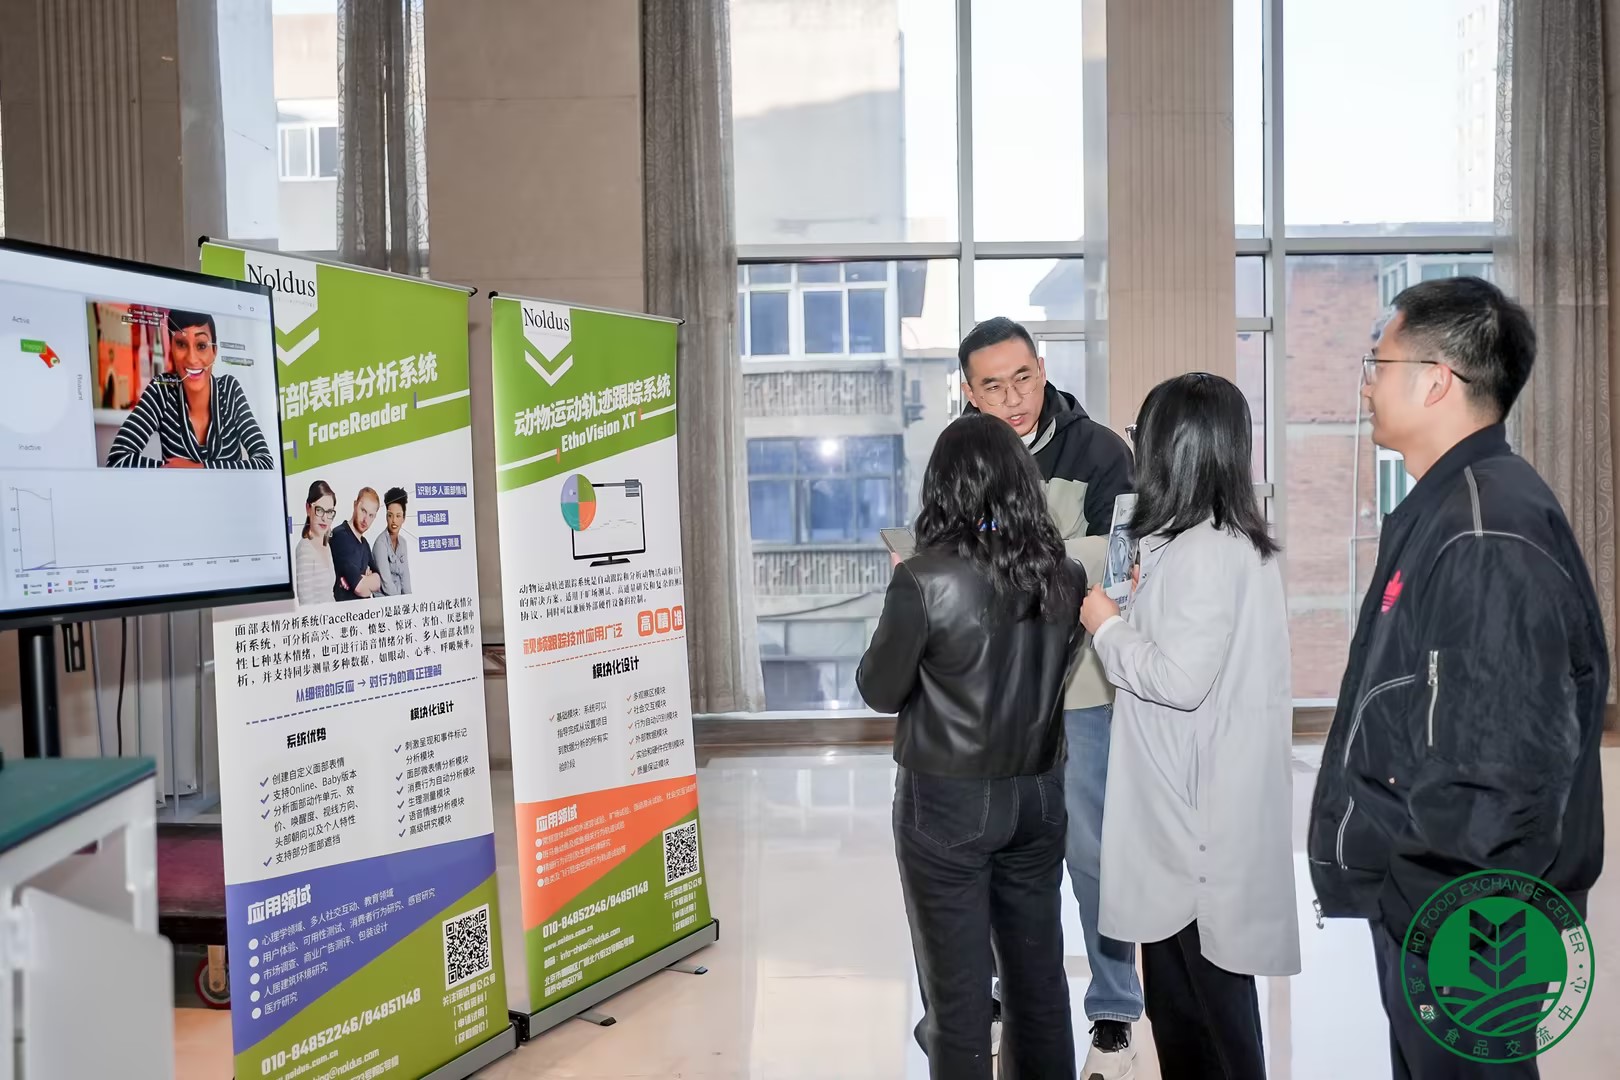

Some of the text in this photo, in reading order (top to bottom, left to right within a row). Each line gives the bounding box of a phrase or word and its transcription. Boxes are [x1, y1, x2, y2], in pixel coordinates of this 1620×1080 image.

[247, 264, 316, 297] Noldus
[523, 308, 570, 331] Noldus
[278, 351, 438, 422] 部表情分析系统
[514, 373, 671, 437] 动物运动轨迹跟踪系统
[308, 402, 408, 447] FaceReader
[561, 411, 636, 452] EthoVision XT
[296, 663, 442, 702] 从细微的反应 对行为的真正理解
[592, 656, 640, 679] 模块化设计
[410, 700, 454, 721] 模块化设计
[286, 727, 327, 749] 系统优势
[272, 756, 345, 786] 创建自定义面部表情
[405, 750, 435, 765] 分析模块
[272, 769, 357, 802] 支持Online、Baby版本
[407, 765, 476, 794] 消费行为自动分析模块
[275, 814, 356, 848] 头部朝向以及个人特性
[409, 814, 452, 836] 高级研究模块
[536, 804, 578, 833] 应用领域
[275, 833, 341, 865] 支持部分面部遮挡
[247, 884, 312, 925] 应用领域
[542, 880, 649, 939] 010-84852246/84851148
[264, 991, 299, 1016] 医疗研究
[261, 987, 422, 1076] 010-84852246/84851148
